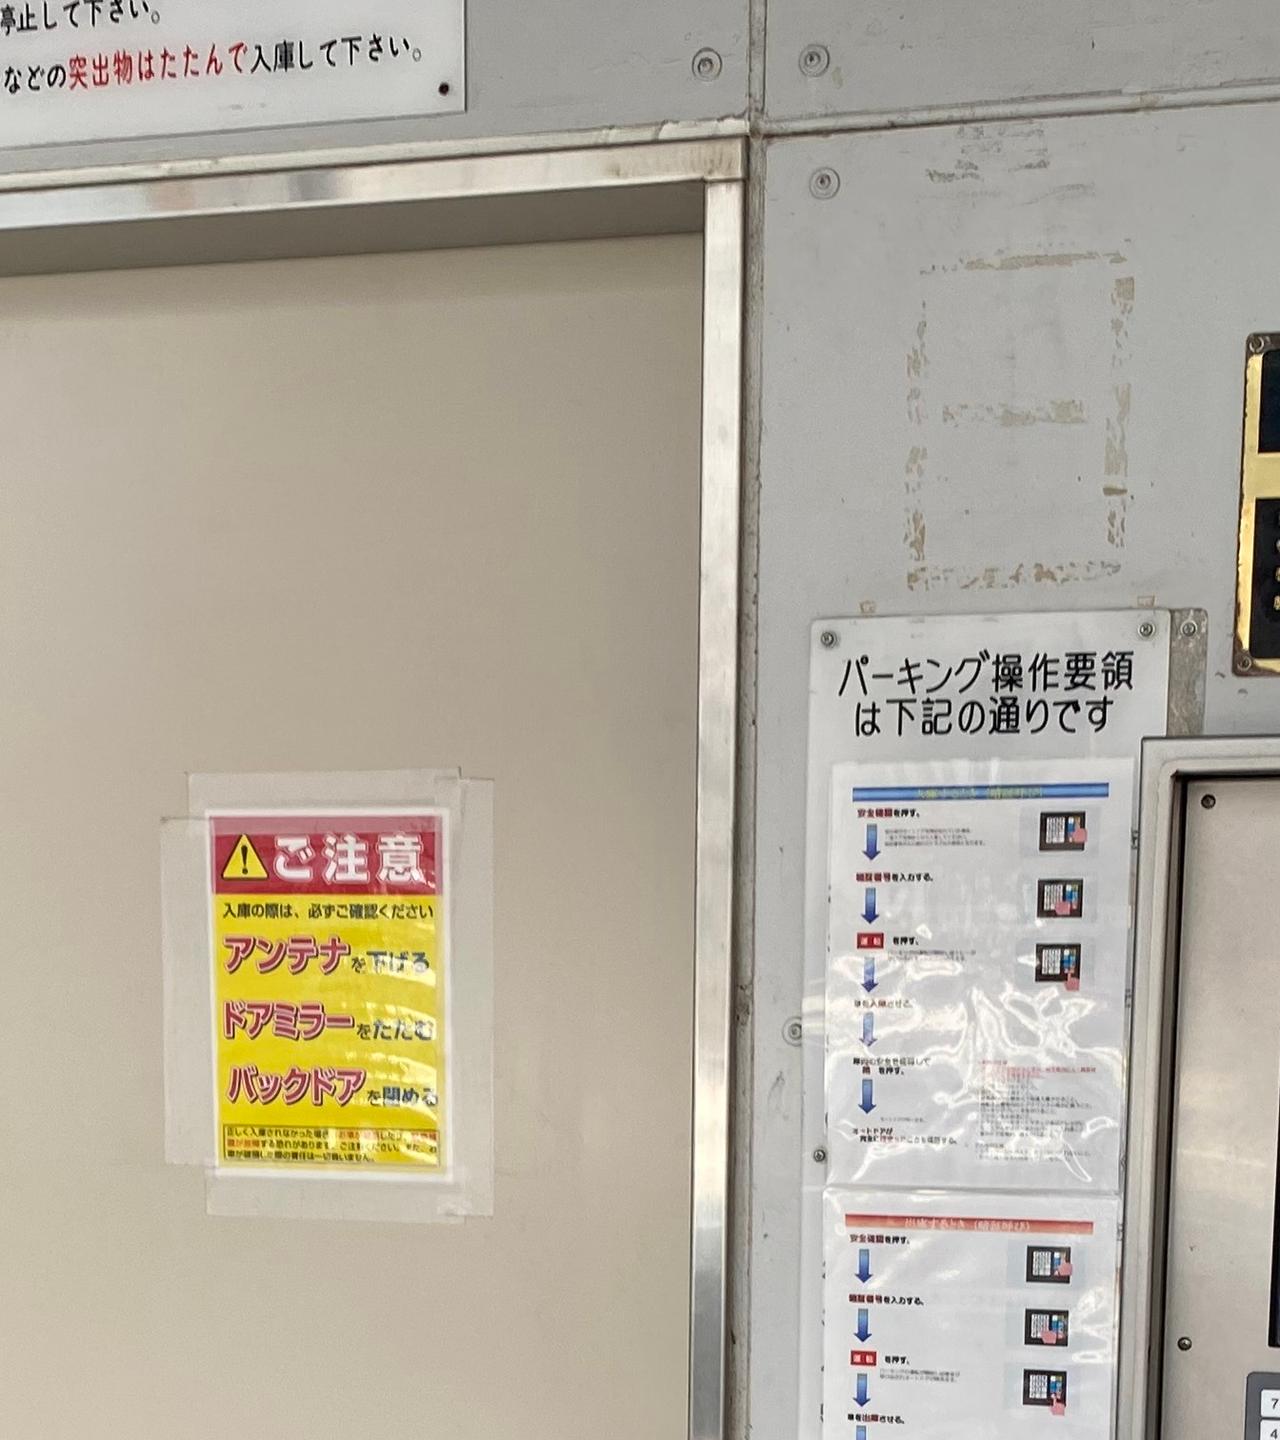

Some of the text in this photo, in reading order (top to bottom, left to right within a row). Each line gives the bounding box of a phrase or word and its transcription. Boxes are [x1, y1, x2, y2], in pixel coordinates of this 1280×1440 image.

[838, 648, 1134, 697] パーキング操作要領
[854, 696, 1115, 737] は下記の通りです
[273, 832, 428, 885] ご注意
[222, 902, 434, 920] 入庫の際は、必ずご確認ください
[222, 998, 434, 1042] ドアミラーをたたむ
[226, 1062, 439, 1107] バックドアを閉める
[1271, 1398, 1279, 1410] 7
[1270, 1428, 1278, 1440] 4
